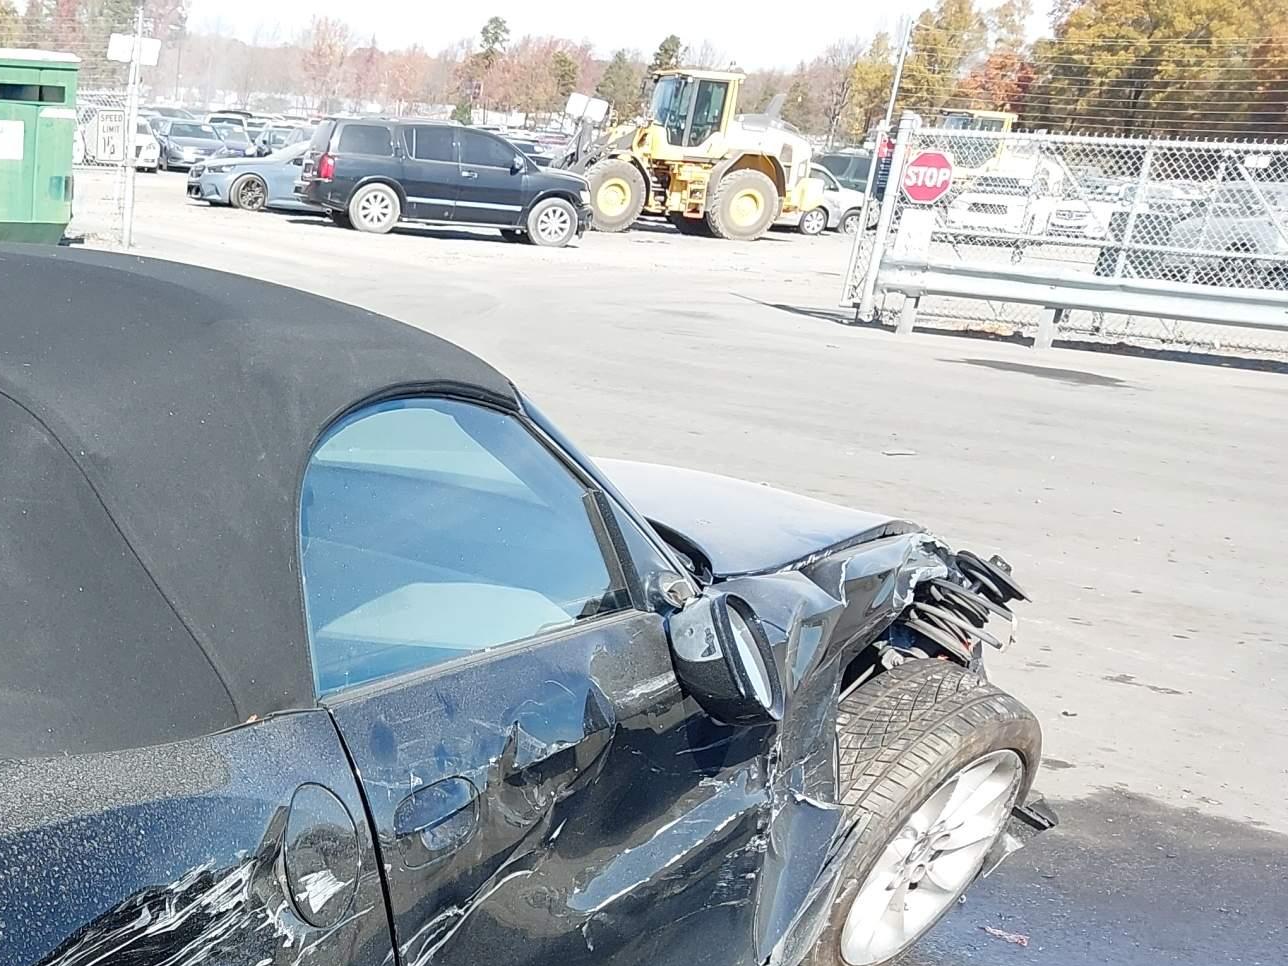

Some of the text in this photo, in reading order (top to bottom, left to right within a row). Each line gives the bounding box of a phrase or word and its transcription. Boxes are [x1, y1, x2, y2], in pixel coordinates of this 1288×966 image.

[100, 114, 123, 122] SPEED
[102, 125, 120, 133] LIMIT
[904, 166, 951, 188] STOP
